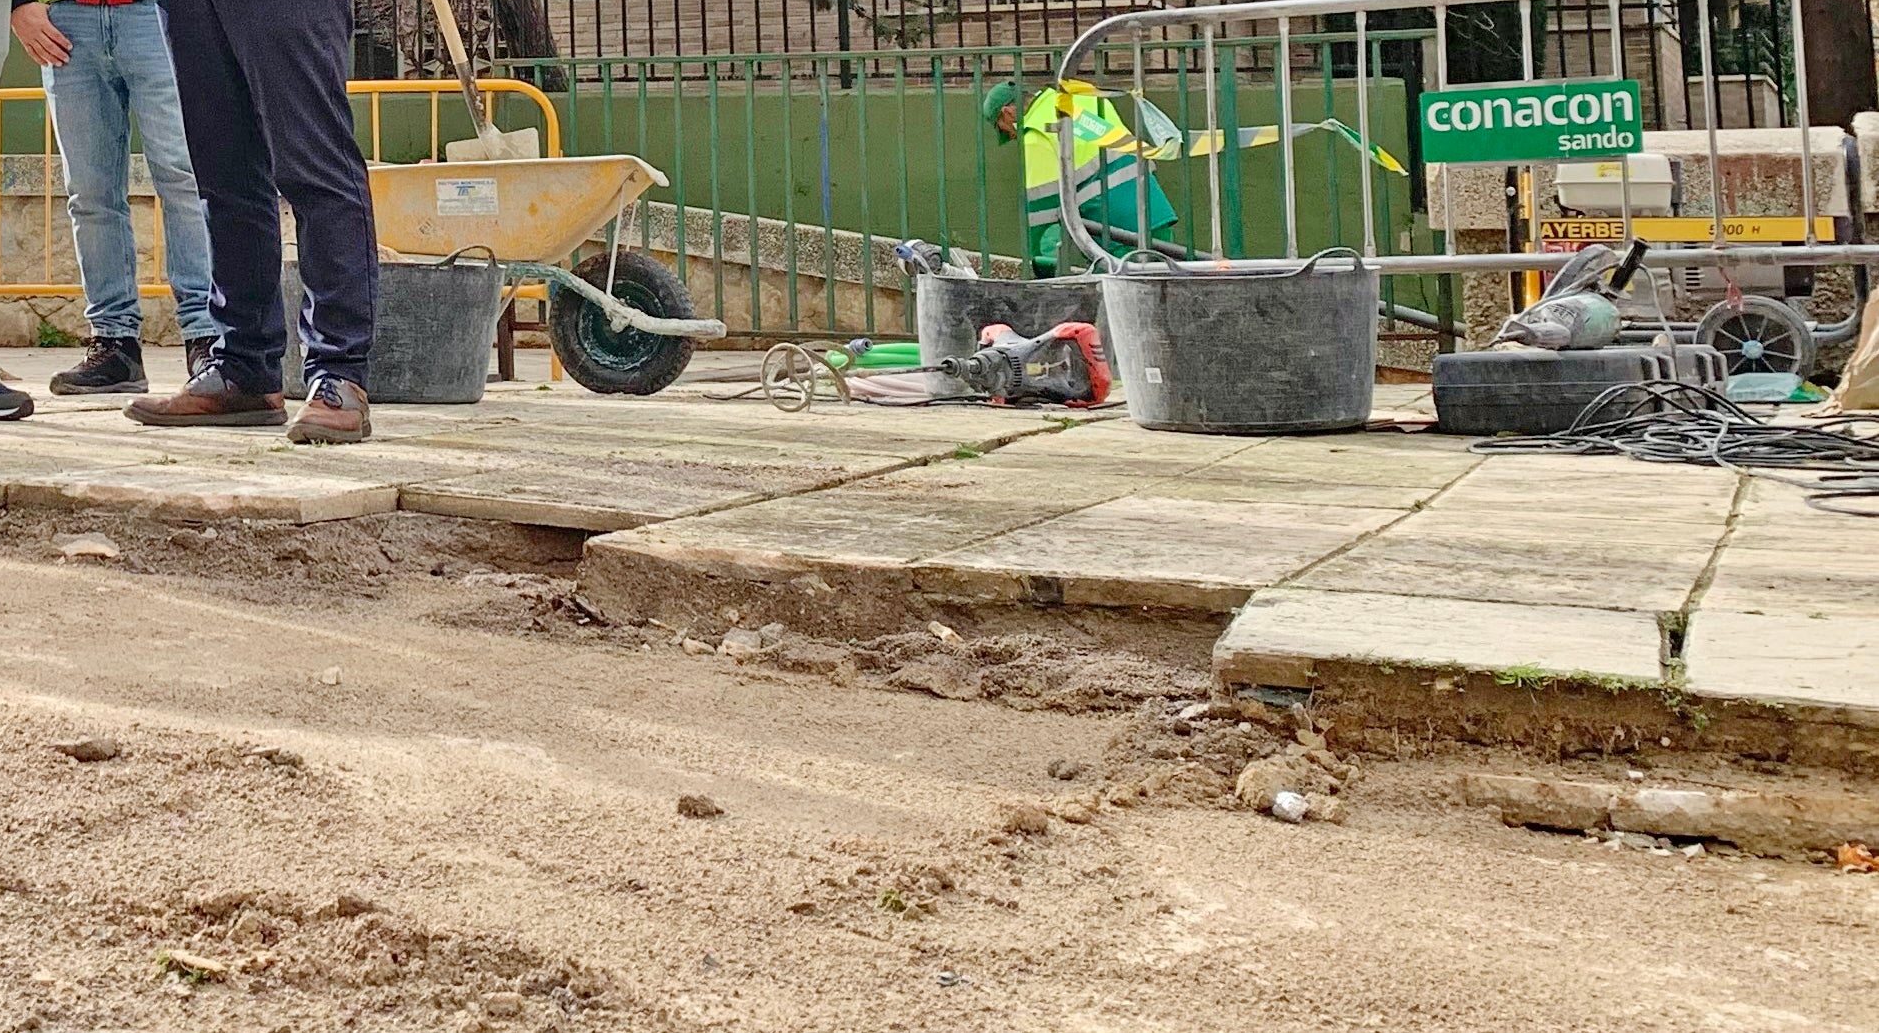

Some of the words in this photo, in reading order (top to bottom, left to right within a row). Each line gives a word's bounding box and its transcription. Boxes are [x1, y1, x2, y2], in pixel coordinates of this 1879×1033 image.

[1427, 90, 1634, 132] conacon
[1558, 125, 1634, 151] sando
[1541, 222, 1624, 238] AYERBE
